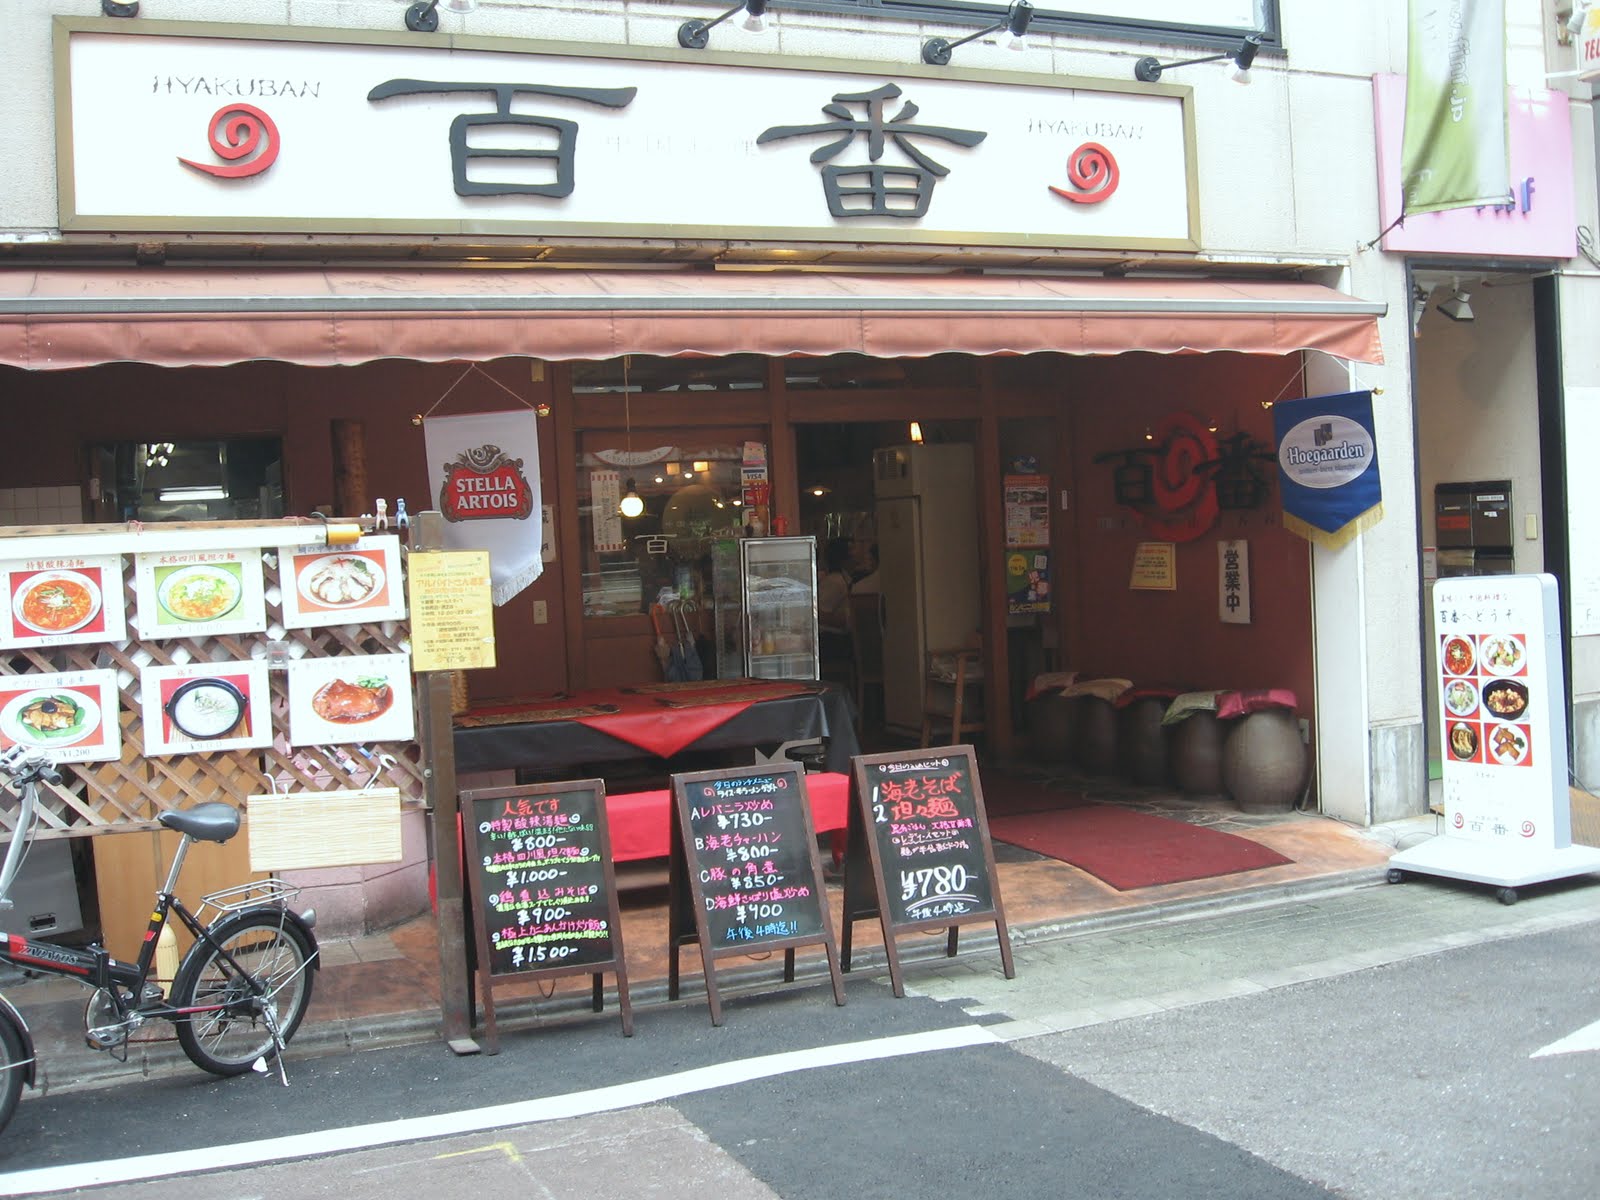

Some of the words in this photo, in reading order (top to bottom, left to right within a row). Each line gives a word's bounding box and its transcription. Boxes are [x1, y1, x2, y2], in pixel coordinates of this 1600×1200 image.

[153, 75, 320, 98] HYAKUBAN
[1028, 118, 1143, 140] HYAKUBAN
[1288, 441, 1364, 465] Hoegaarden
[456, 476, 515, 492] STELLA
[457, 493, 518, 509] ARTOIS
[1224, 549, 1241, 613] 営業中
[881, 772, 962, 803] 海老そば
[503, 798, 560, 816] 人気です
